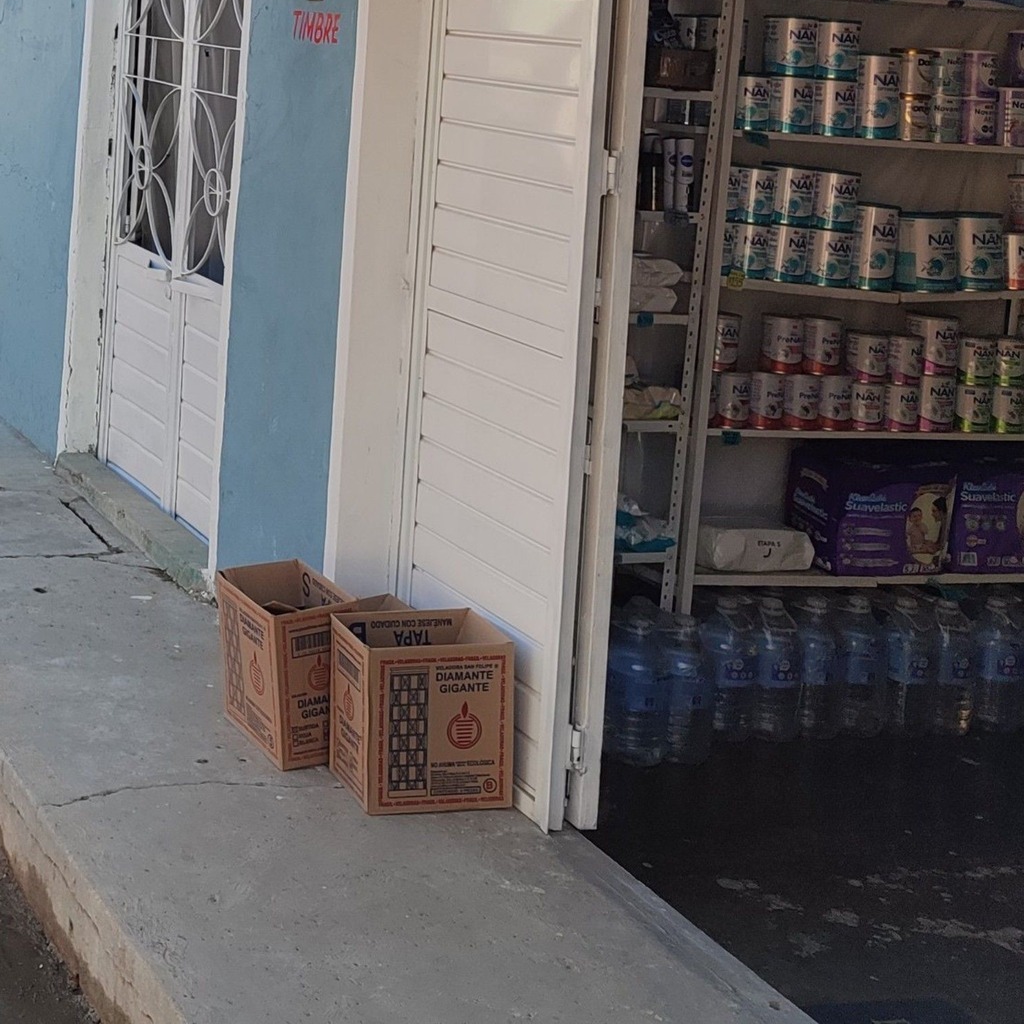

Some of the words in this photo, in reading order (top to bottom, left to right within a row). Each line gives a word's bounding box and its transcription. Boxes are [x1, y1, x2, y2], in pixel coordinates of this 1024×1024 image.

[293, 10, 341, 44] TIMBRE
[832, 33, 860, 44] NAN
[794, 88, 813, 100] NA
[728, 177, 740, 187] AN
[789, 238, 807, 248] NA
[996, 348, 1021, 359] NAN
[856, 392, 881, 403] NAN
[960, 492, 1017, 502] Suavelastic
[844, 501, 908, 513] Suavelastic
[370, 620, 401, 629] CUIDADO
[401, 620, 416, 628] CON
[393, 629, 432, 646] TAPA
[435, 670, 494, 682] DIAMANTE
[439, 682, 490, 694] GIGANTE
[297, 695, 330, 709] DIAMA
